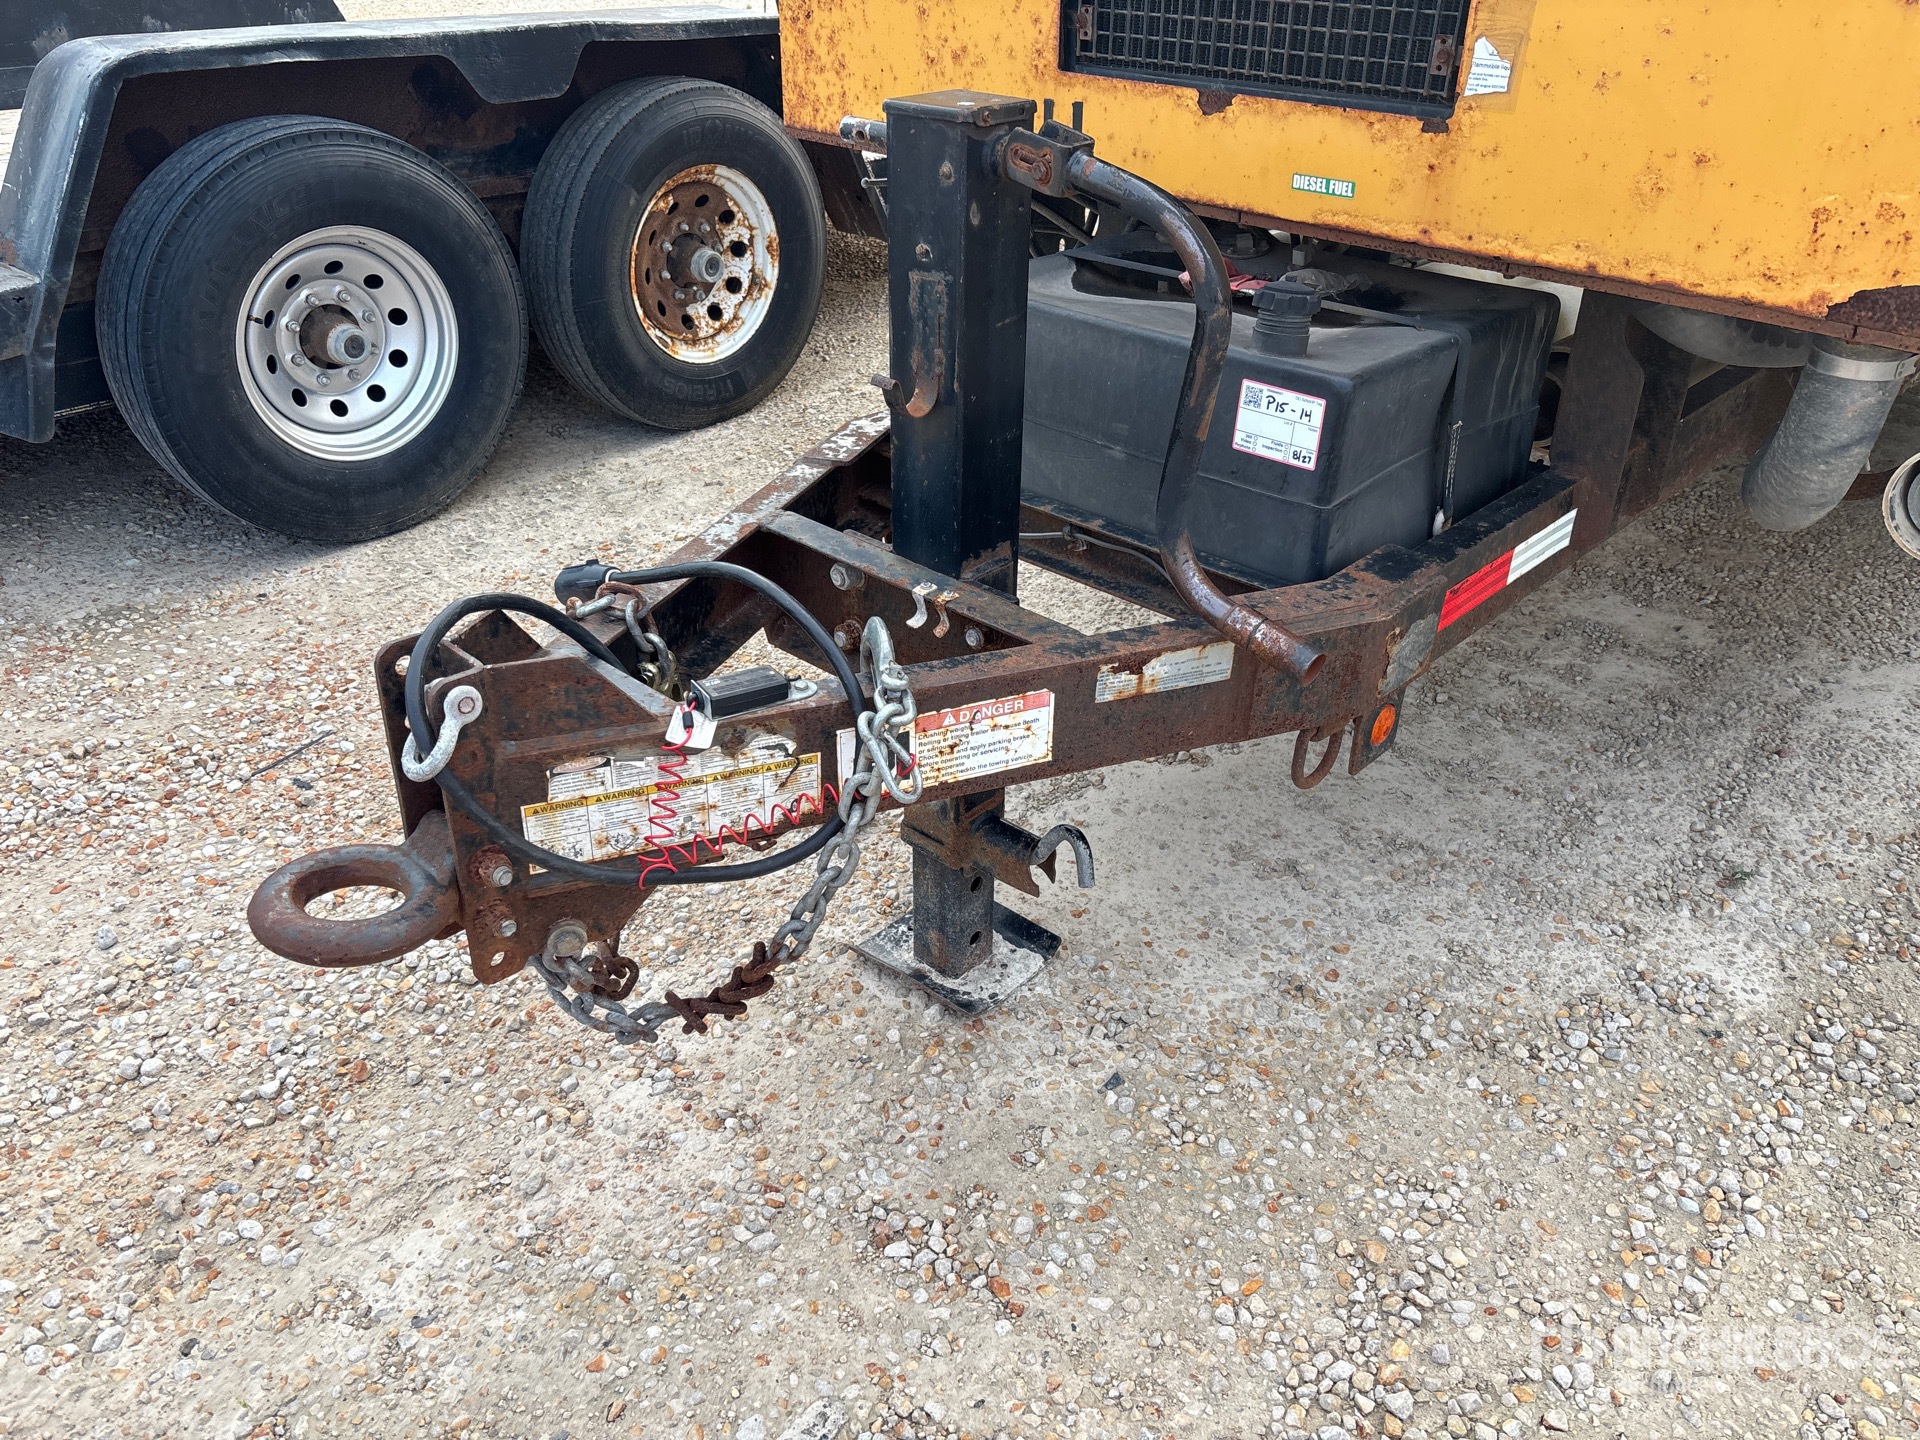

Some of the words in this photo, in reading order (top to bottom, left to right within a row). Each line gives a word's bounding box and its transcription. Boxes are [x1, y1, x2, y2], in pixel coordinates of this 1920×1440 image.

[1293, 174, 1327, 192] DIESEL
[1329, 180, 1353, 197] FUEL
[960, 699, 1024, 722] DANGER
[918, 730, 948, 741] Crushing
[950, 724, 972, 735] weigh
[918, 738, 941, 748] Rolling
[1022, 717, 1040, 725] death
[918, 753, 938, 762] Chock
[970, 743, 986, 752] apply
[988, 738, 1011, 748] parking
[927, 744, 949, 753] seriou
[940, 754, 971, 764] operating
[941, 762, 965, 771] operate
[941, 768, 969, 778] attached
[988, 759, 1009, 767] towing
[540, 799, 584, 813] WARNING
[602, 787, 645, 801] WARNING
[720, 768, 759, 780] WARNING
